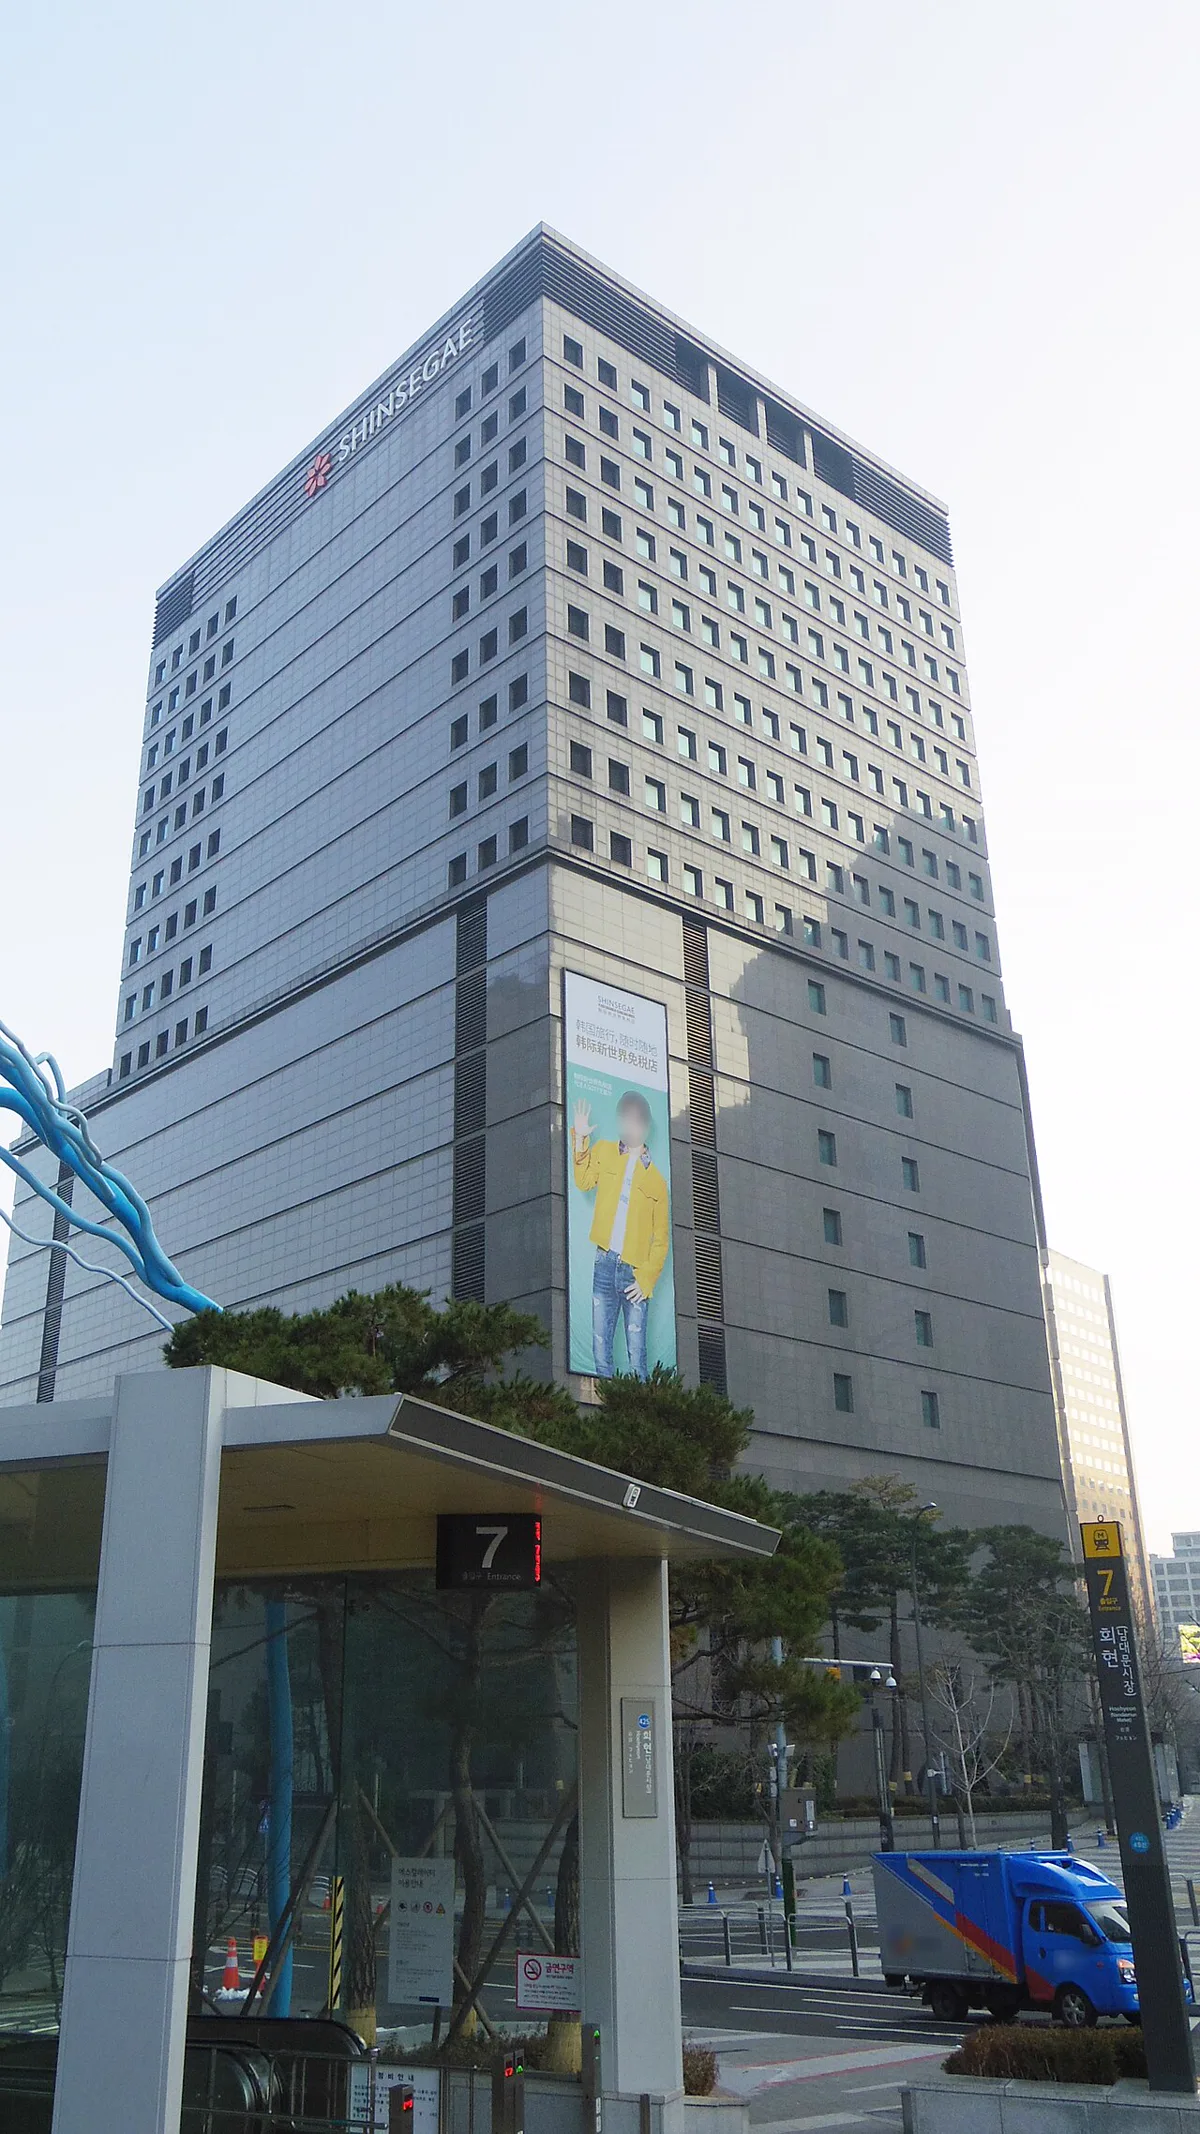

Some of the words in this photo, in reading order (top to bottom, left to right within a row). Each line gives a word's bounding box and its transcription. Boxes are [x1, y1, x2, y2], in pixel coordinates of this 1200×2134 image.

[338, 318, 474, 462] SHINSEGAE
[597, 995, 635, 1014] SHINSEGAE
[576, 1034, 658, 1073] 韩际新世界免税店
[475, 1526, 509, 1569] 7
[487, 1572, 522, 1581] Entrance
[1096, 1569, 1114, 1596] 7
[1100, 1626, 1118, 1668] 회현
[1116, 1625, 1137, 1696] (남대문시장)
[545, 1962, 574, 1974] 금연구역
